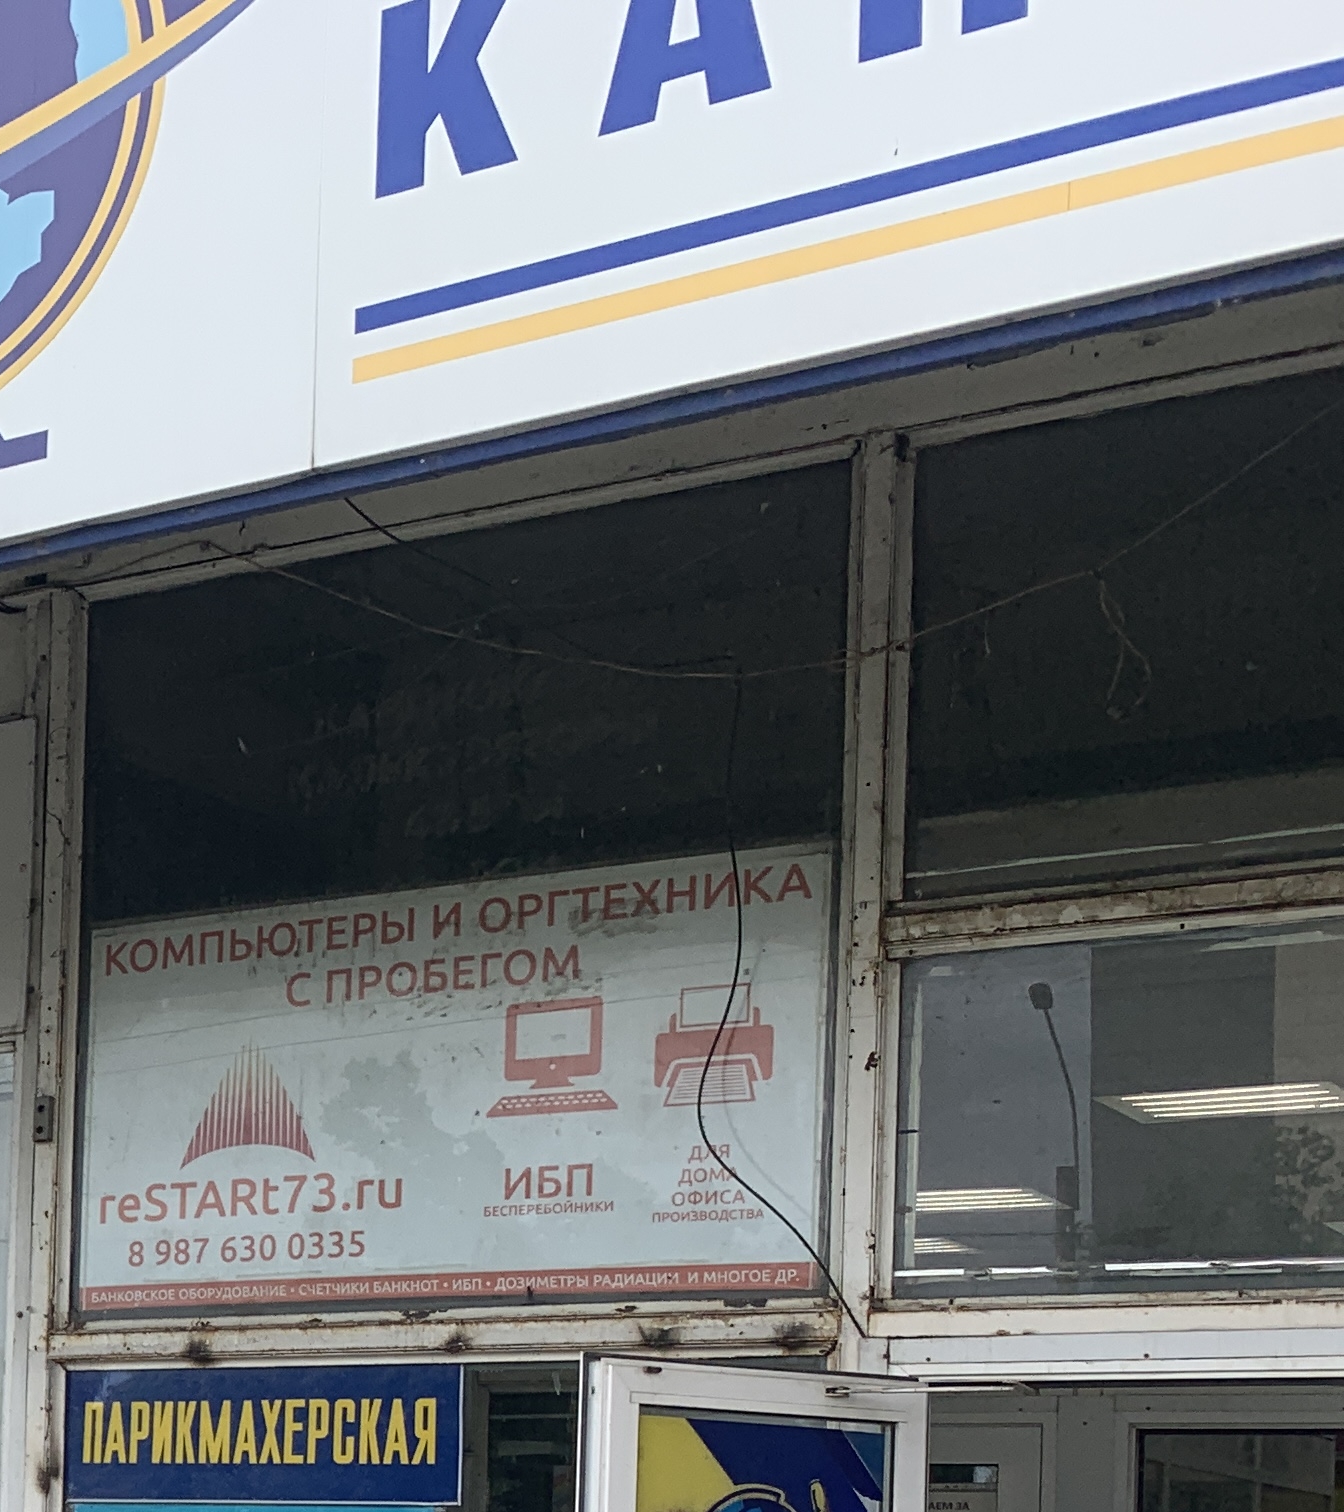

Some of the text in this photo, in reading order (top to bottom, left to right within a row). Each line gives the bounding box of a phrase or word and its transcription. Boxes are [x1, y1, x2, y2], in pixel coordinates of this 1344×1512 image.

[105, 863, 813, 977] КОМПЬЮТЕРЫ И ОРГТЕХНИКА
[286, 944, 580, 1007] С ПРОБЕГОМ
[687, 1143, 731, 1162] ДЛЯ
[504, 1163, 593, 1200] ИБП
[678, 1166, 738, 1188] ДОМА
[483, 1201, 615, 1218] БЕСПЕРЕБОЙНИКИ
[652, 1208, 764, 1225] ПРОИЗВОДСТВА
[671, 1189, 745, 1208] ОФИСА
[128, 1230, 365, 1267] 8 987 630 0335
[91, 1289, 175, 1304] БАНКОВСКОЕ
[178, 1284, 287, 1301] ОБОРУДОВАНИЕ
[299, 1281, 369, 1297] СЧЕТЧИКИ
[373, 1278, 439, 1294] БАНКНОТ
[452, 1278, 482, 1292] ИБП
[494, 1274, 591, 1292] ДОЗИМЕТРЫ
[702, 1270, 771, 1286] МНОГОЕ
[774, 1268, 800, 1286] ДР.
[82, 1396, 437, 1466] ПАРИКМАХЕРСКАЯ
